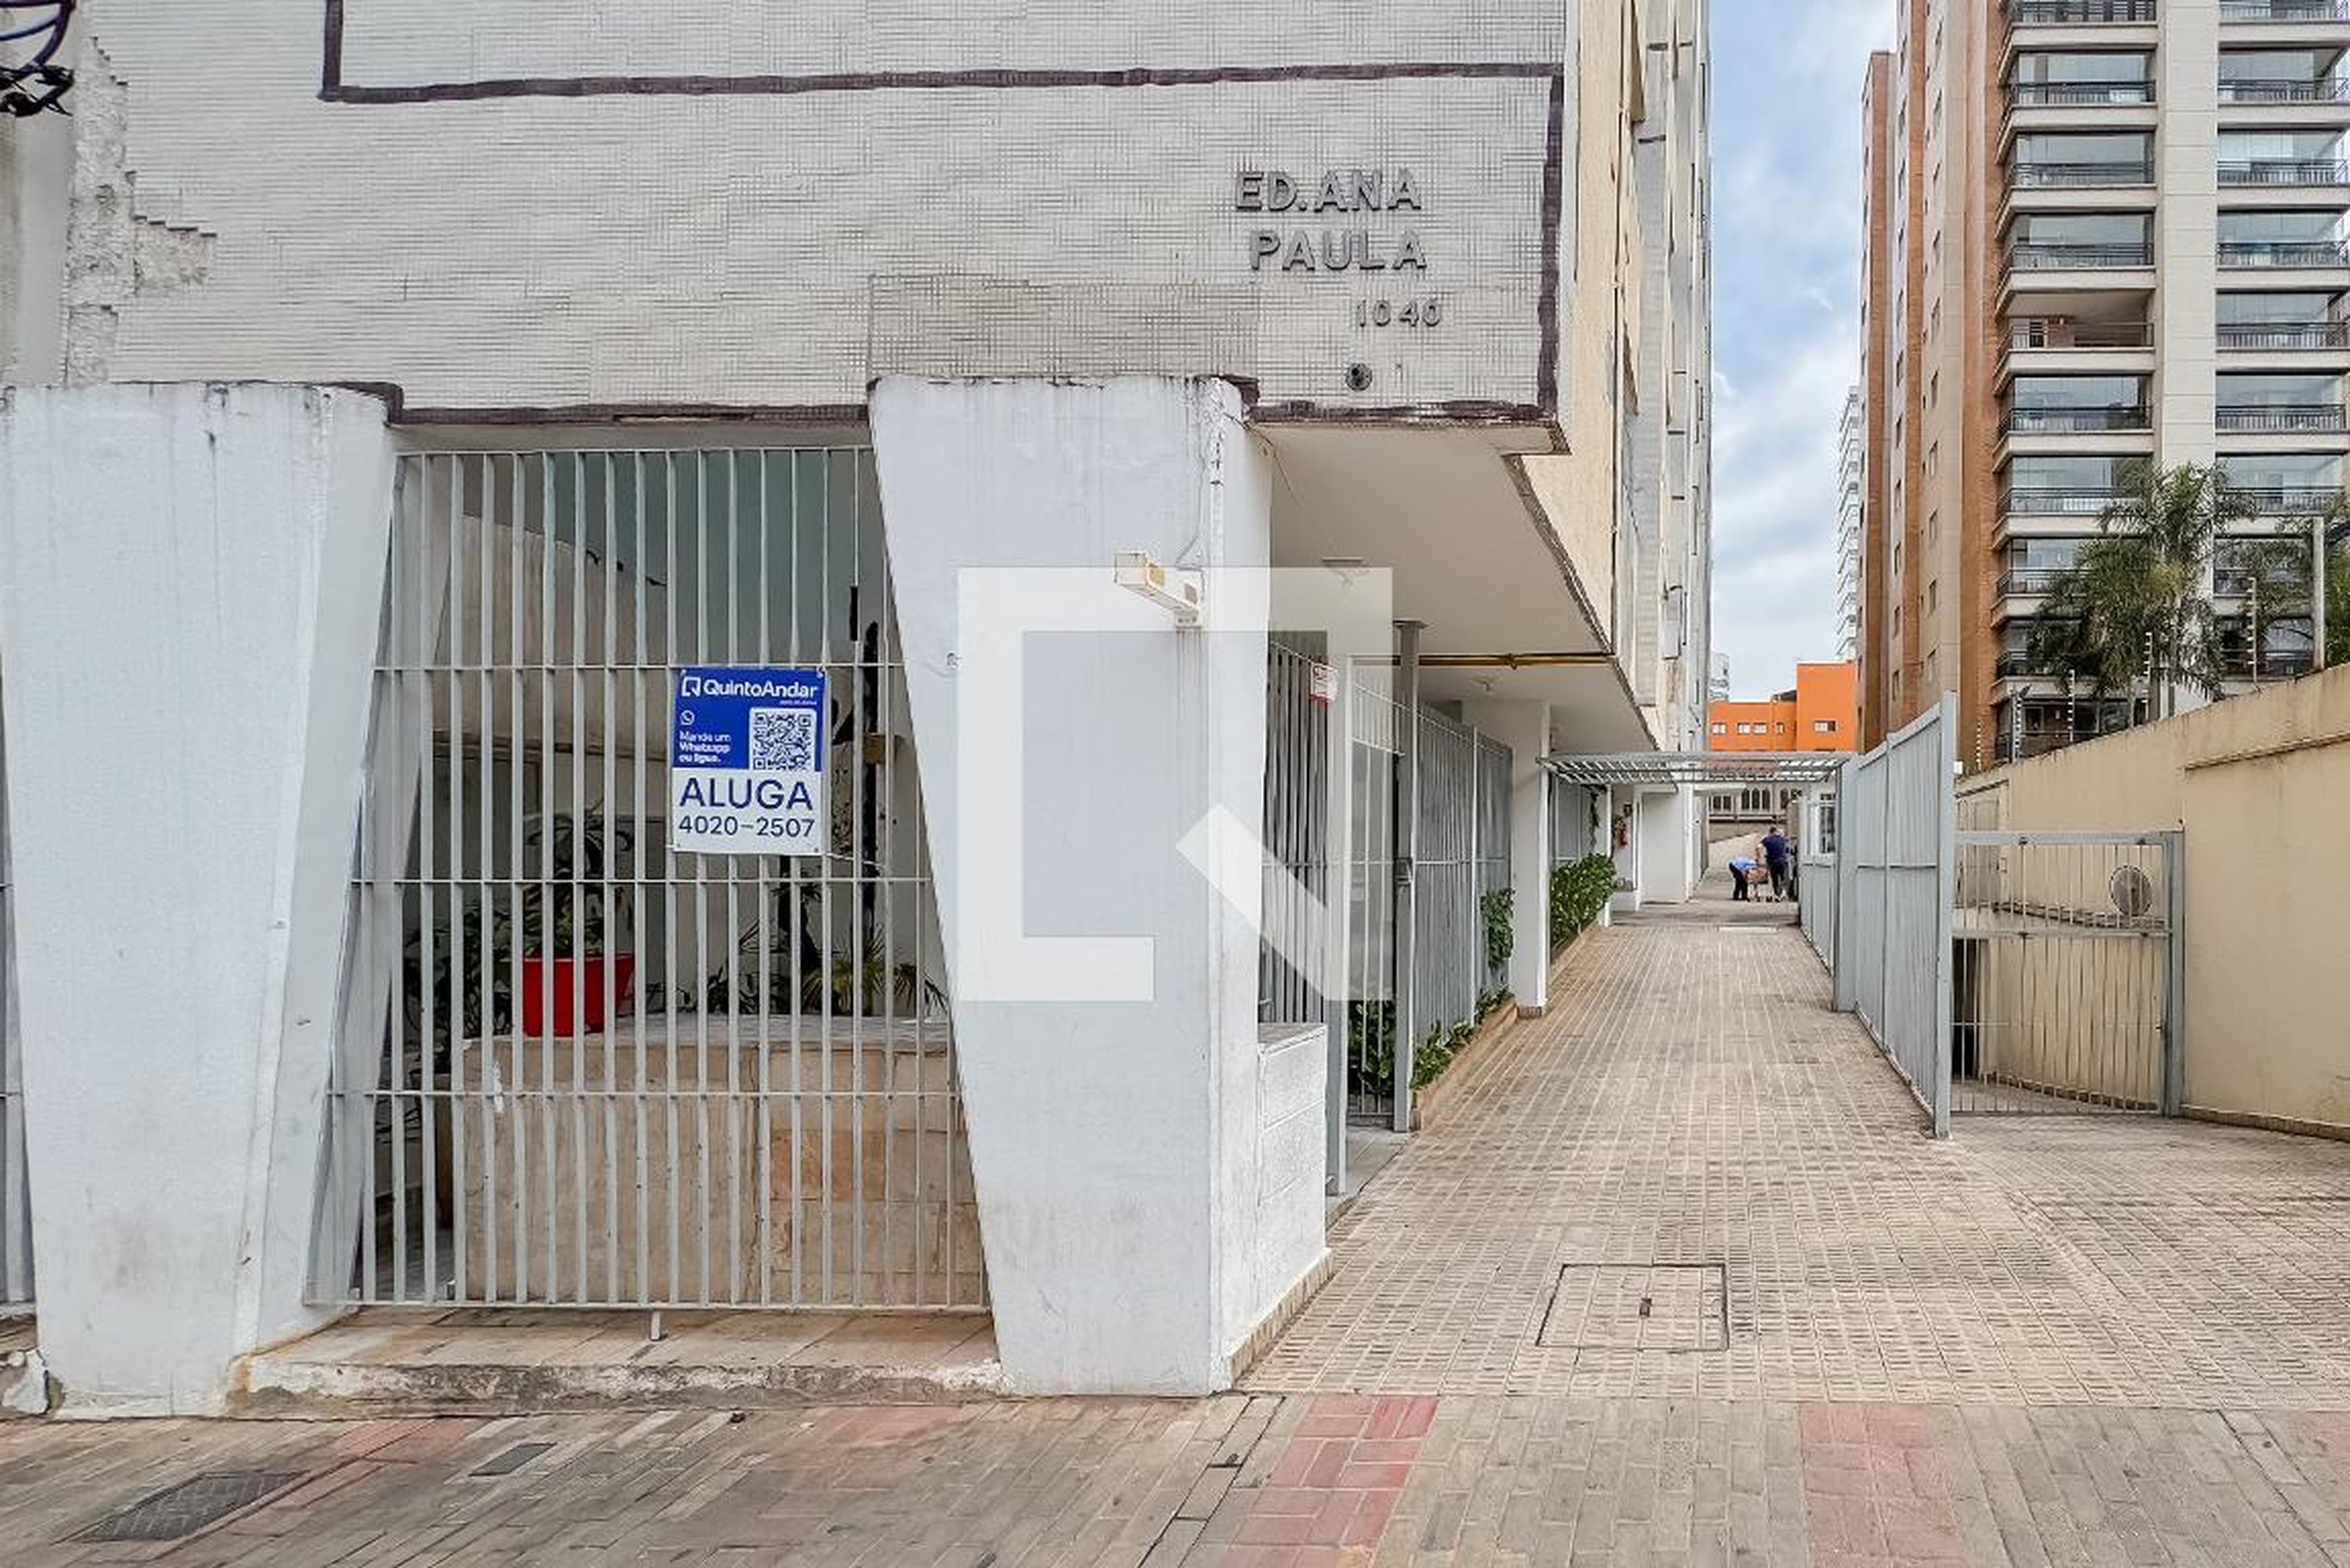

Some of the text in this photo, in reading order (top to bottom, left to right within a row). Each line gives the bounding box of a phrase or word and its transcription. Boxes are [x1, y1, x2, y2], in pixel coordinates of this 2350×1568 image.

[1250, 229, 1427, 271] PAULA
[1356, 299, 1442, 327] 1040
[704, 679, 818, 698] QuintoAndar
[679, 777, 813, 810] ALUGA
[679, 815, 815, 837] 4020-2507
